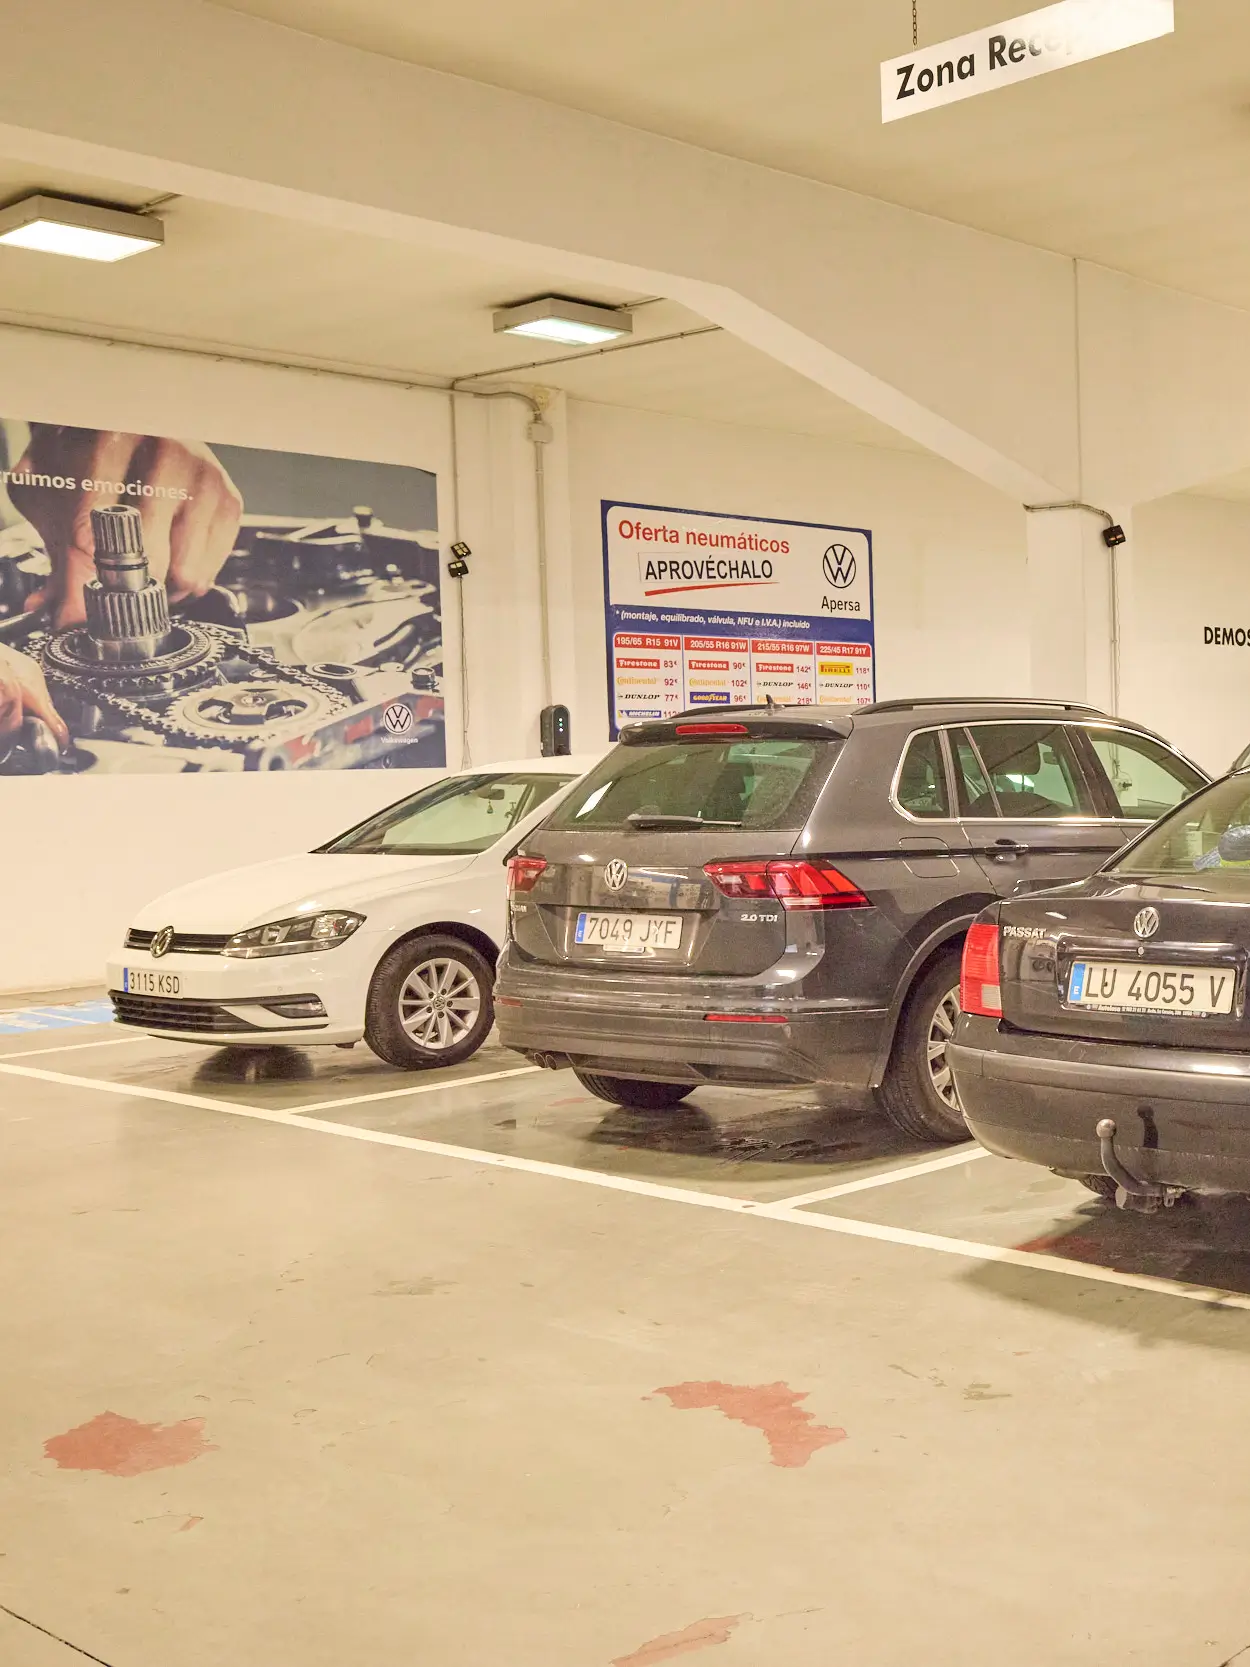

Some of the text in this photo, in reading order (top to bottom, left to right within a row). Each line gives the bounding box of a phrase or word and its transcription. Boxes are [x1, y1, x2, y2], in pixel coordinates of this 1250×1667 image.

[896, 53, 975, 100] Zona
[81, 478, 194, 501] emociones.
[618, 520, 790, 554] Oferta neumáticos
[645, 555, 773, 580] APROVÉCHALO
[821, 596, 861, 613] Apersa
[621, 610, 659, 622] (montaje,
[661, 613, 706, 625] equilibrado,
[707, 616, 736, 626] válvula,
[737, 617, 754, 626] NFU
[782, 620, 810, 629] incluido
[616, 636, 679, 647] 195/65 R15 91V
[715, 641, 730, 650] R16
[781, 644, 795, 652] R16
[842, 647, 855, 655] R17
[619, 659, 658, 667] Firestone
[691, 660, 727, 669] Firestone
[759, 914, 778, 922] TDI
[587, 917, 633, 942] 7049
[640, 919, 676, 944] JYF
[1003, 926, 1047, 938] PASSAT
[129, 972, 155, 992] 3115
[158, 974, 180, 994] KSD
[1073, 967, 1226, 1008] E LU 4055 V
